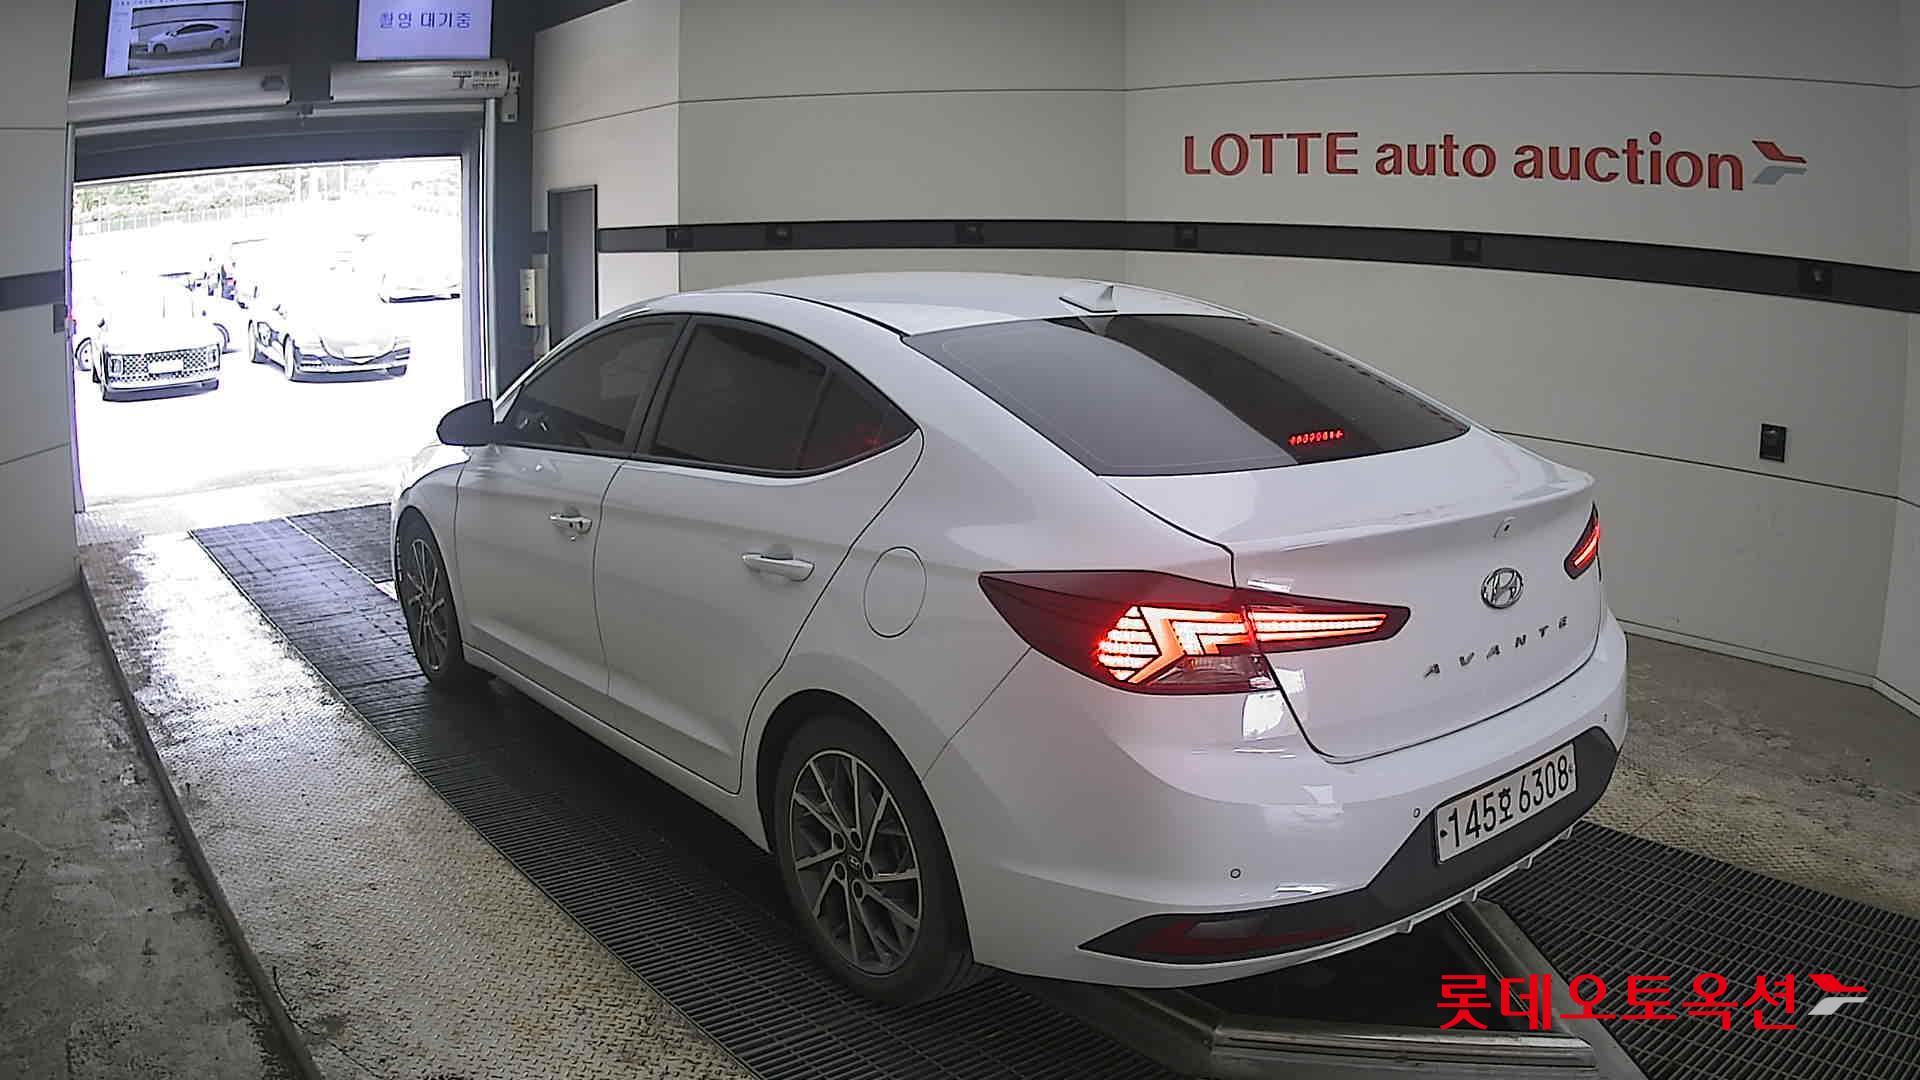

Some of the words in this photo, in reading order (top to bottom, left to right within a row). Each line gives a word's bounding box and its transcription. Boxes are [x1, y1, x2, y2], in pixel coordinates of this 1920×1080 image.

[420, 11, 472, 29] 대기중
[1184, 132, 1359, 176] LOTTE
[1375, 134, 1497, 178] auto
[1513, 131, 1744, 191] auction
[1424, 616, 1568, 678] AVANTE
